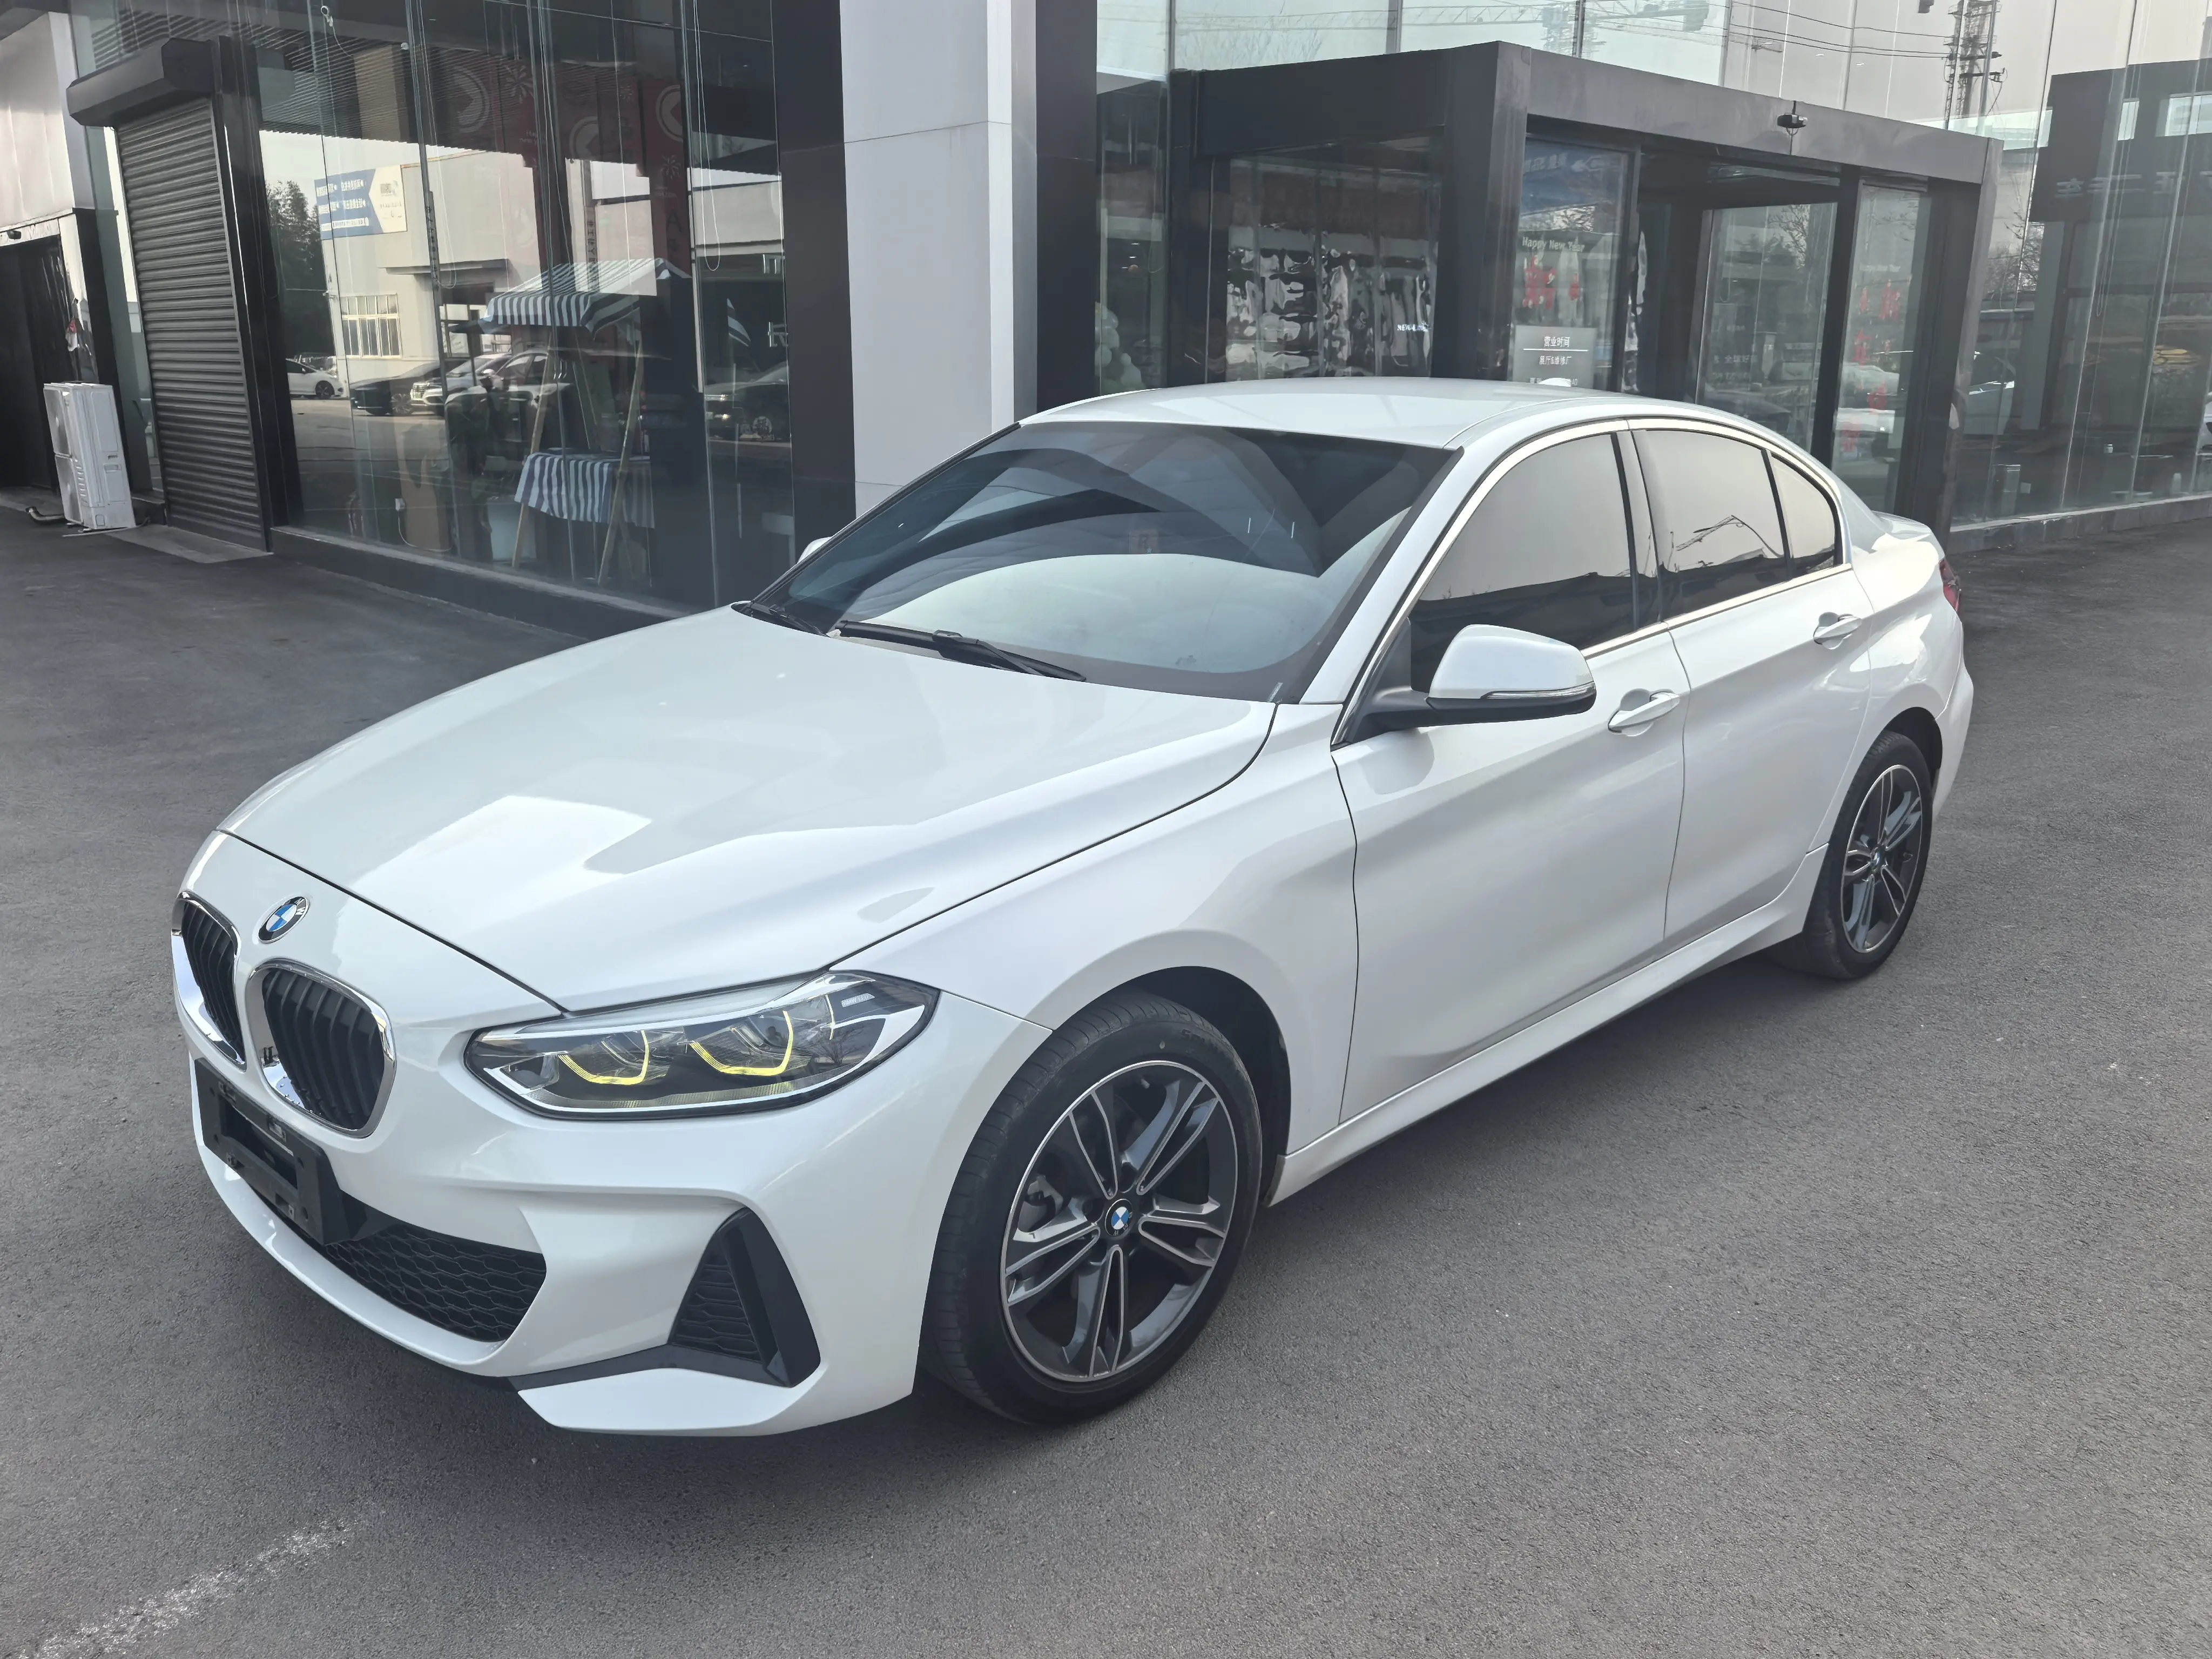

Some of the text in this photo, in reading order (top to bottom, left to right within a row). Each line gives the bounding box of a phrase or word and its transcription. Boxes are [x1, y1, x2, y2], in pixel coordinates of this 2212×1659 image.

[1522, 236, 1585, 253] Happy New Year
[1544, 336, 1570, 347] 营业时间
[1539, 355, 1572, 365] 展厅&维修厂
[842, 997, 857, 1007] BMW
